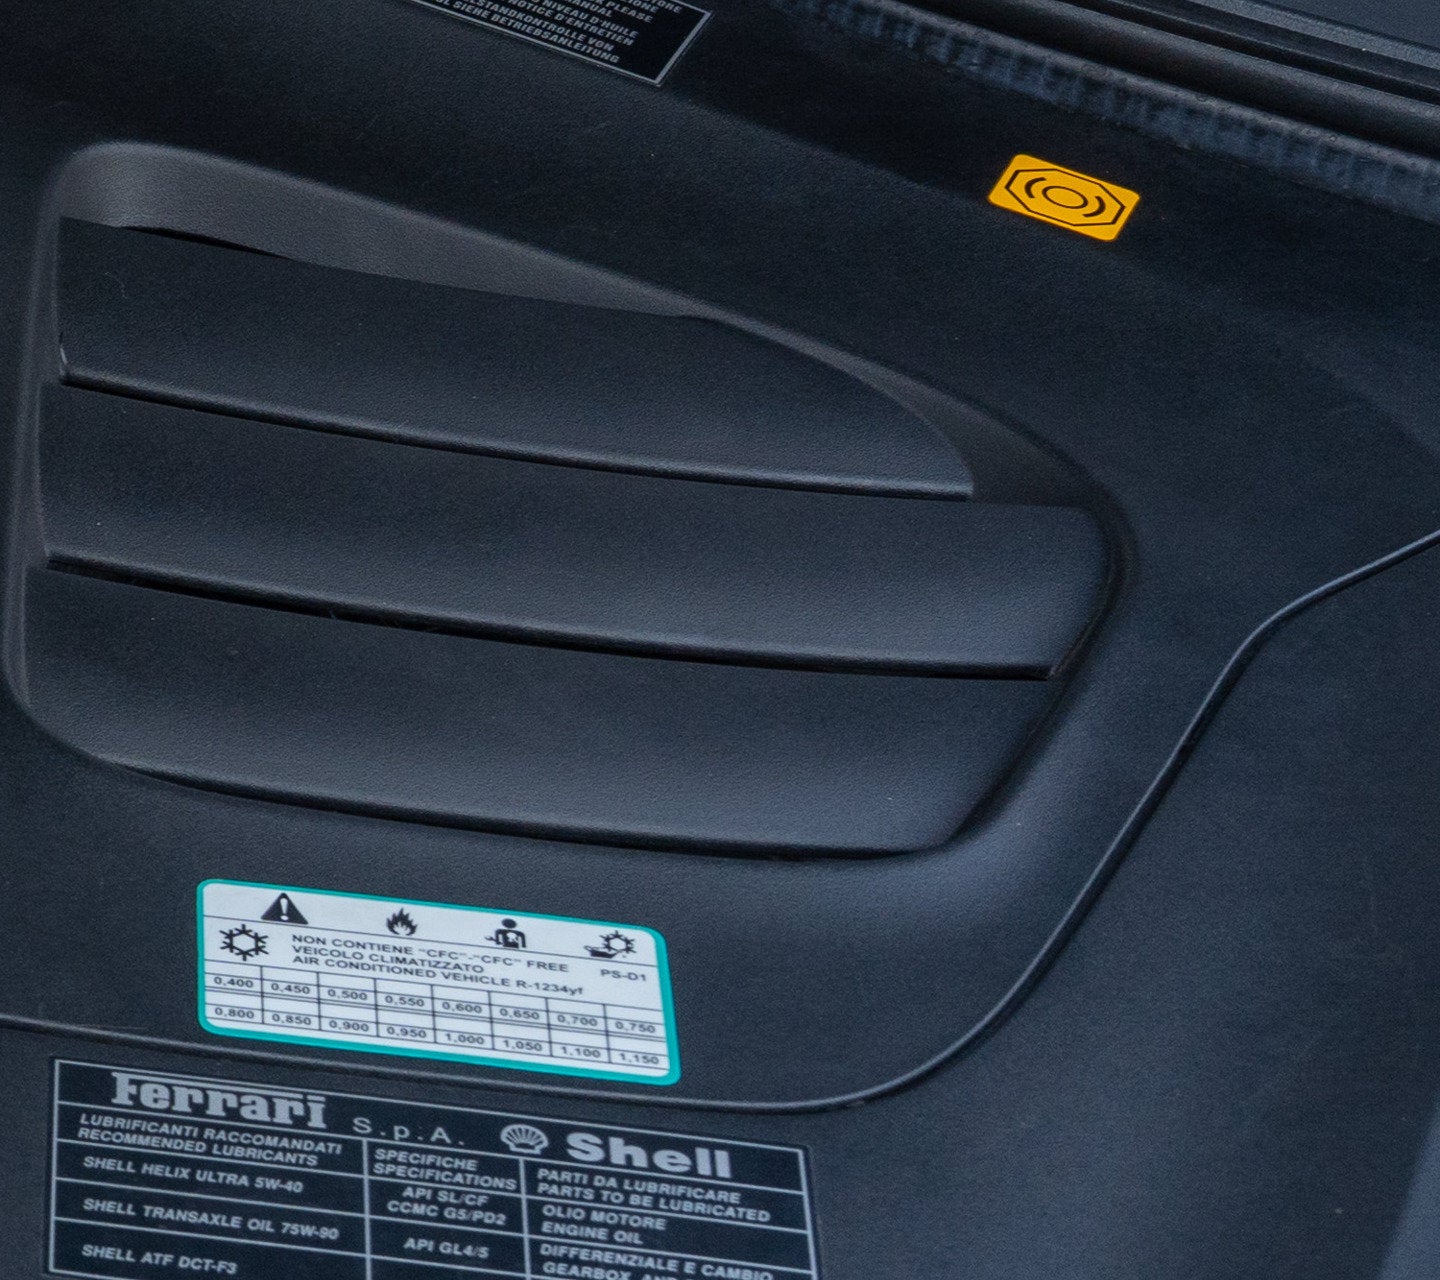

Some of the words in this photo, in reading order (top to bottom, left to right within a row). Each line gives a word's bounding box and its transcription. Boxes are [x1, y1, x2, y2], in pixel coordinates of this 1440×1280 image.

[452, 0, 490, 18] SIEHE
[541, 0, 588, 20] NIVEAU
[605, 0, 654, 23] PLEASE
[586, 37, 614, 51] VON
[291, 934, 326, 947] NON
[331, 938, 413, 956] CONTIENE
[526, 959, 569, 973] FREE
[291, 945, 364, 962] VEICOLO
[368, 953, 484, 974] CLIMATIZZATO
[292, 955, 319, 967] AIR
[323, 958, 437, 980] CONDITIONED
[441, 971, 510, 987] VEHICLE
[600, 969, 647, 982] PS-D1
[111, 1071, 326, 1129] Ferrari
[77, 1126, 206, 1154] RECOMMENDED
[211, 1143, 318, 1167] LUBRICANTS
[80, 1112, 198, 1138] LUBRIFICANTI
[203, 1127, 342, 1156] RACCOMANDATI
[374, 1148, 478, 1172] SPECIFICHE
[565, 1130, 731, 1178] Shell
[83, 1155, 135, 1173] SHELL
[142, 1163, 190, 1180] HELIX
[196, 1169, 248, 1187] ULTRA
[254, 1176, 303, 1194] 5W-40
[372, 1162, 517, 1191] SPECIFICATIONS
[536, 1168, 589, 1185] PARTI
[593, 1174, 619, 1189] DA
[622, 1178, 741, 1204] LUBRIFICARE
[402, 1185, 431, 1200] API
[436, 1190, 489, 1207] SL/CF
[536, 1182, 594, 1201] PARTS
[600, 1190, 624, 1205] TO
[628, 1193, 653, 1208] BE
[658, 1197, 771, 1223] LUBRICATED
[83, 1197, 135, 1215] SHELL
[143, 1205, 241, 1229] TRANSAXLE
[247, 1218, 274, 1233] OIL
[281, 1222, 339, 1241] 75W-90
[386, 1199, 439, 1218] CCMC
[443, 1206, 506, 1226] G5/PD2
[541, 1204, 586, 1221] OLIO
[590, 1210, 666, 1231] MOTORE
[404, 1237, 433, 1252] API
[540, 1220, 608, 1241] ENGINE
[613, 1229, 644, 1245] OIL
[82, 1244, 134, 1263] SHELL
[141, 1251, 173, 1268] ATF
[178, 1256, 237, 1276] DCT-F3
[540, 1243, 679, 1273] DIFFERENZIALE
[683, 1261, 697, 1275] E
